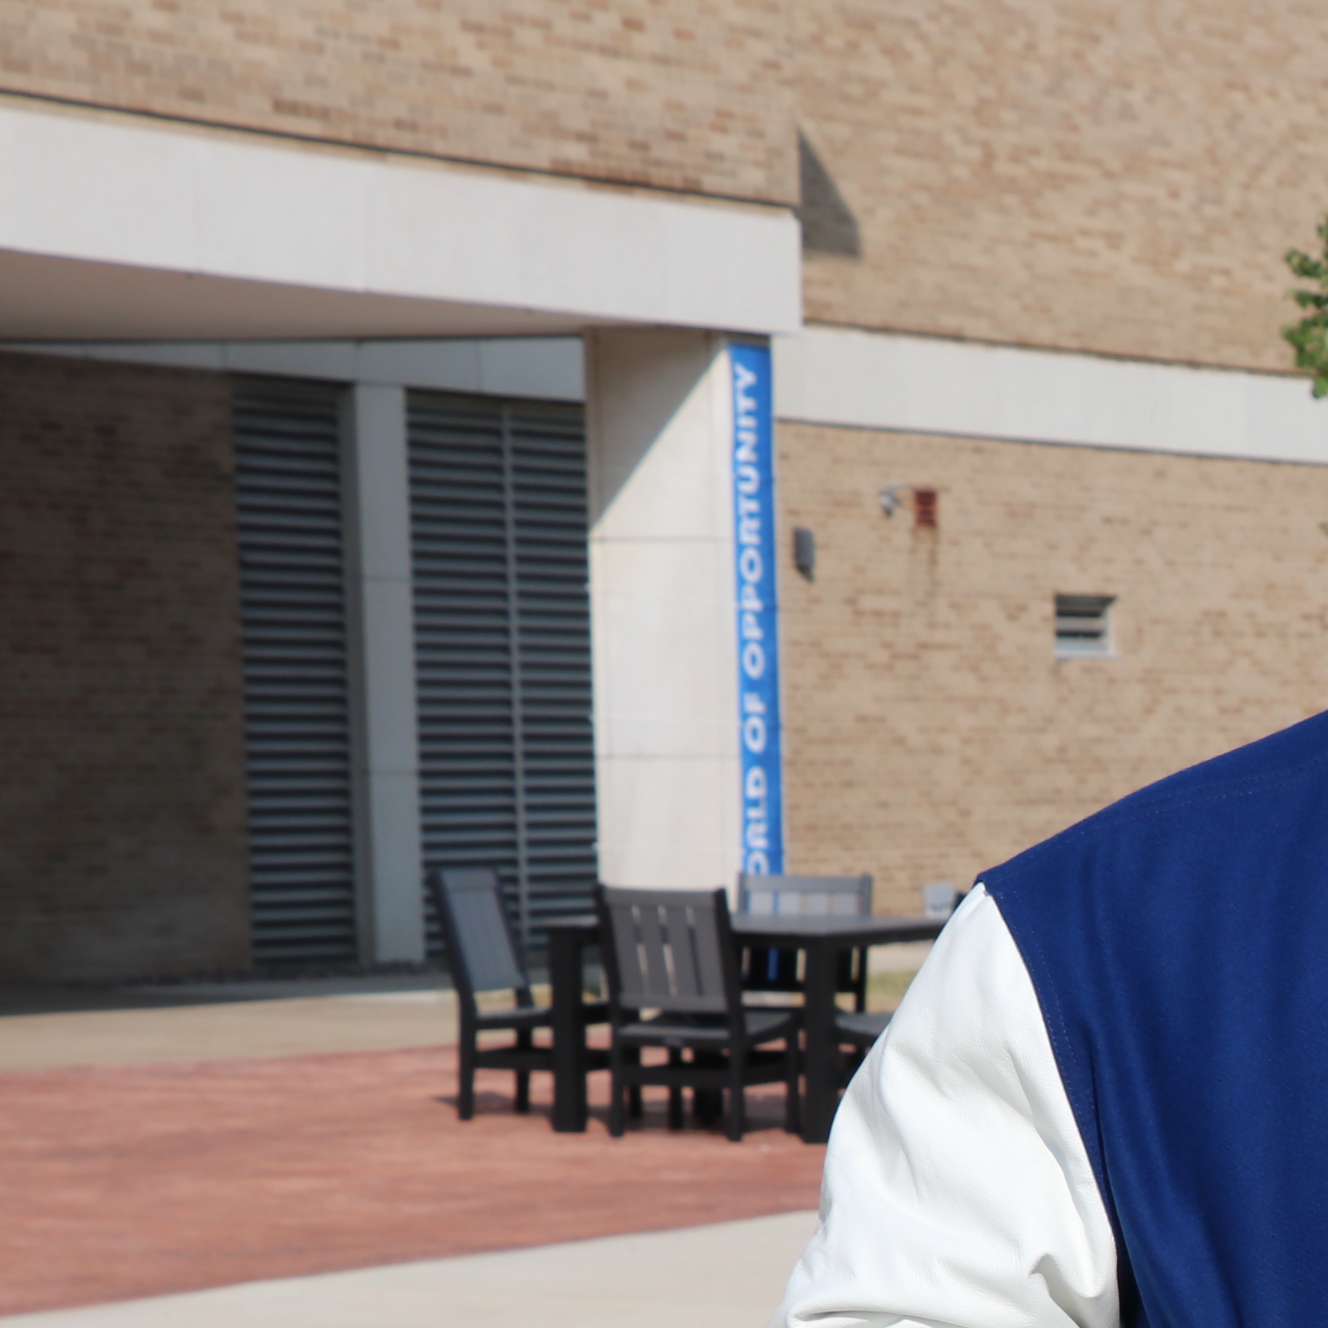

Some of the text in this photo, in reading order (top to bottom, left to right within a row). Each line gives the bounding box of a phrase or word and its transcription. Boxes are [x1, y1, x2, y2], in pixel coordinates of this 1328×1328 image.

[734, 362, 769, 874] ORLD OF OPPORTUNITY
